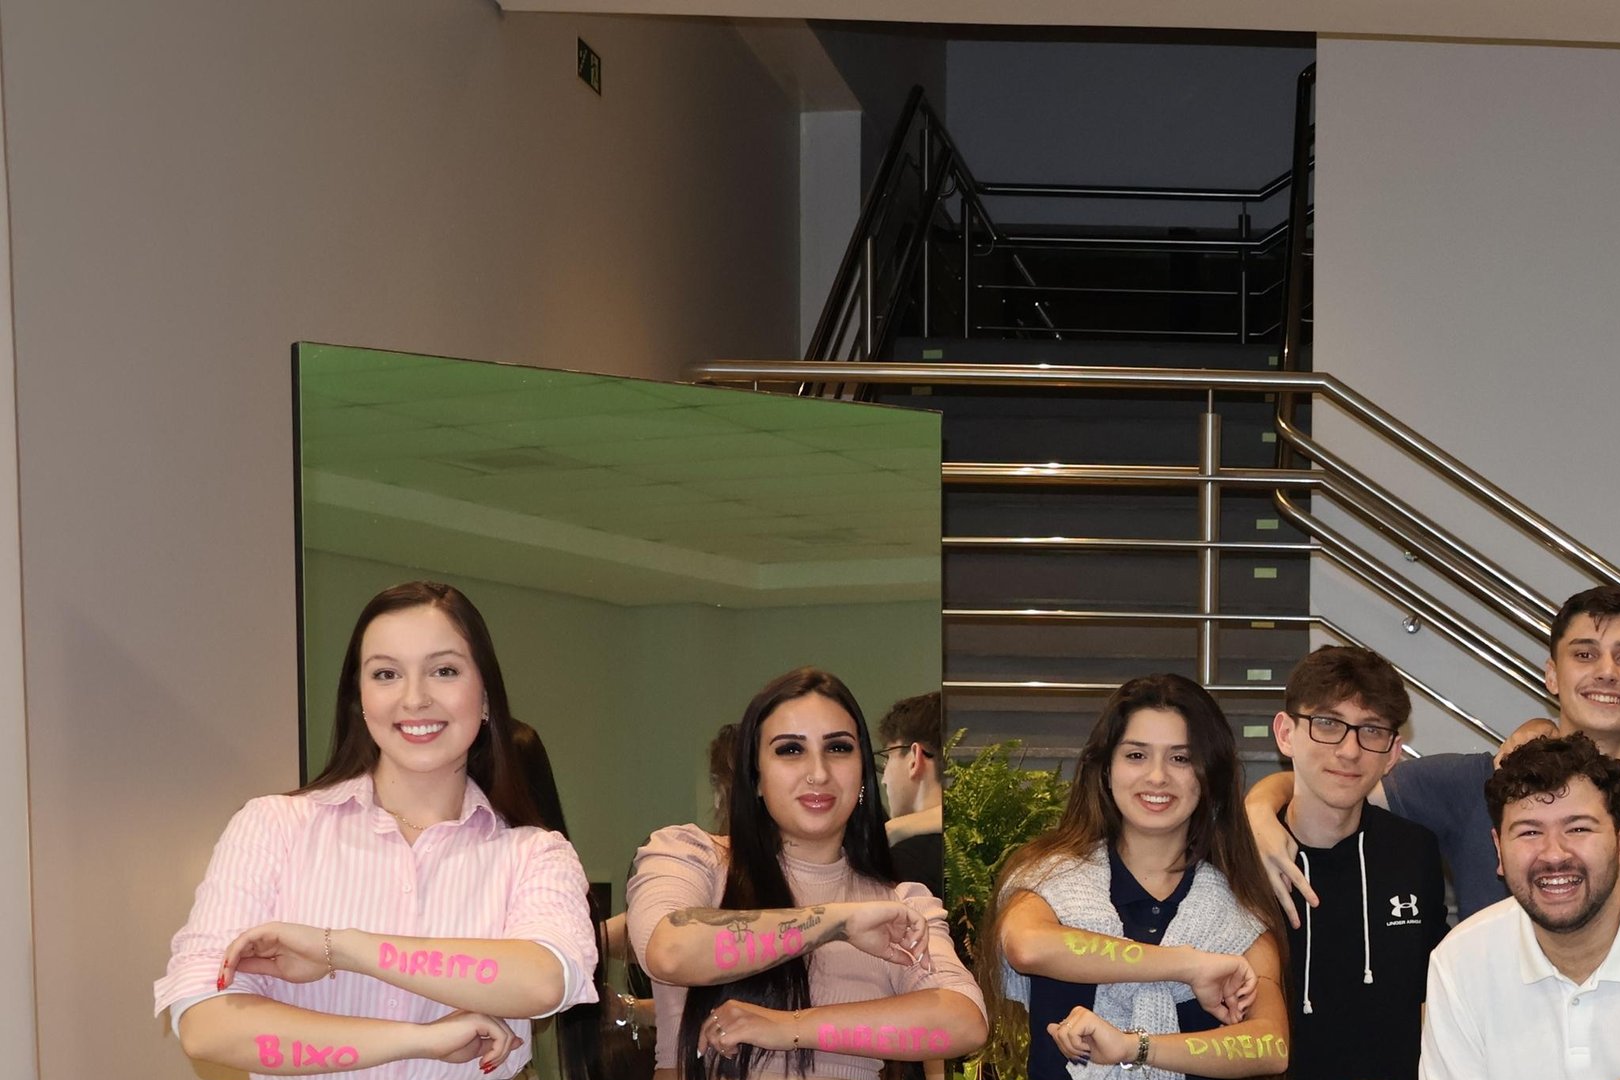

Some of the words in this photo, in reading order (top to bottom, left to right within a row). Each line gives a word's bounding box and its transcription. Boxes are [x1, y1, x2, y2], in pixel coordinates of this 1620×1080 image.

[1386, 919, 1406, 927] UNDER
[378, 941, 499, 985] DIREITO
[714, 927, 804, 970] BIXO
[254, 1034, 361, 1070] BIXO
[817, 1023, 952, 1054] DIREITO
[1184, 1032, 1289, 1061] DIREITO
